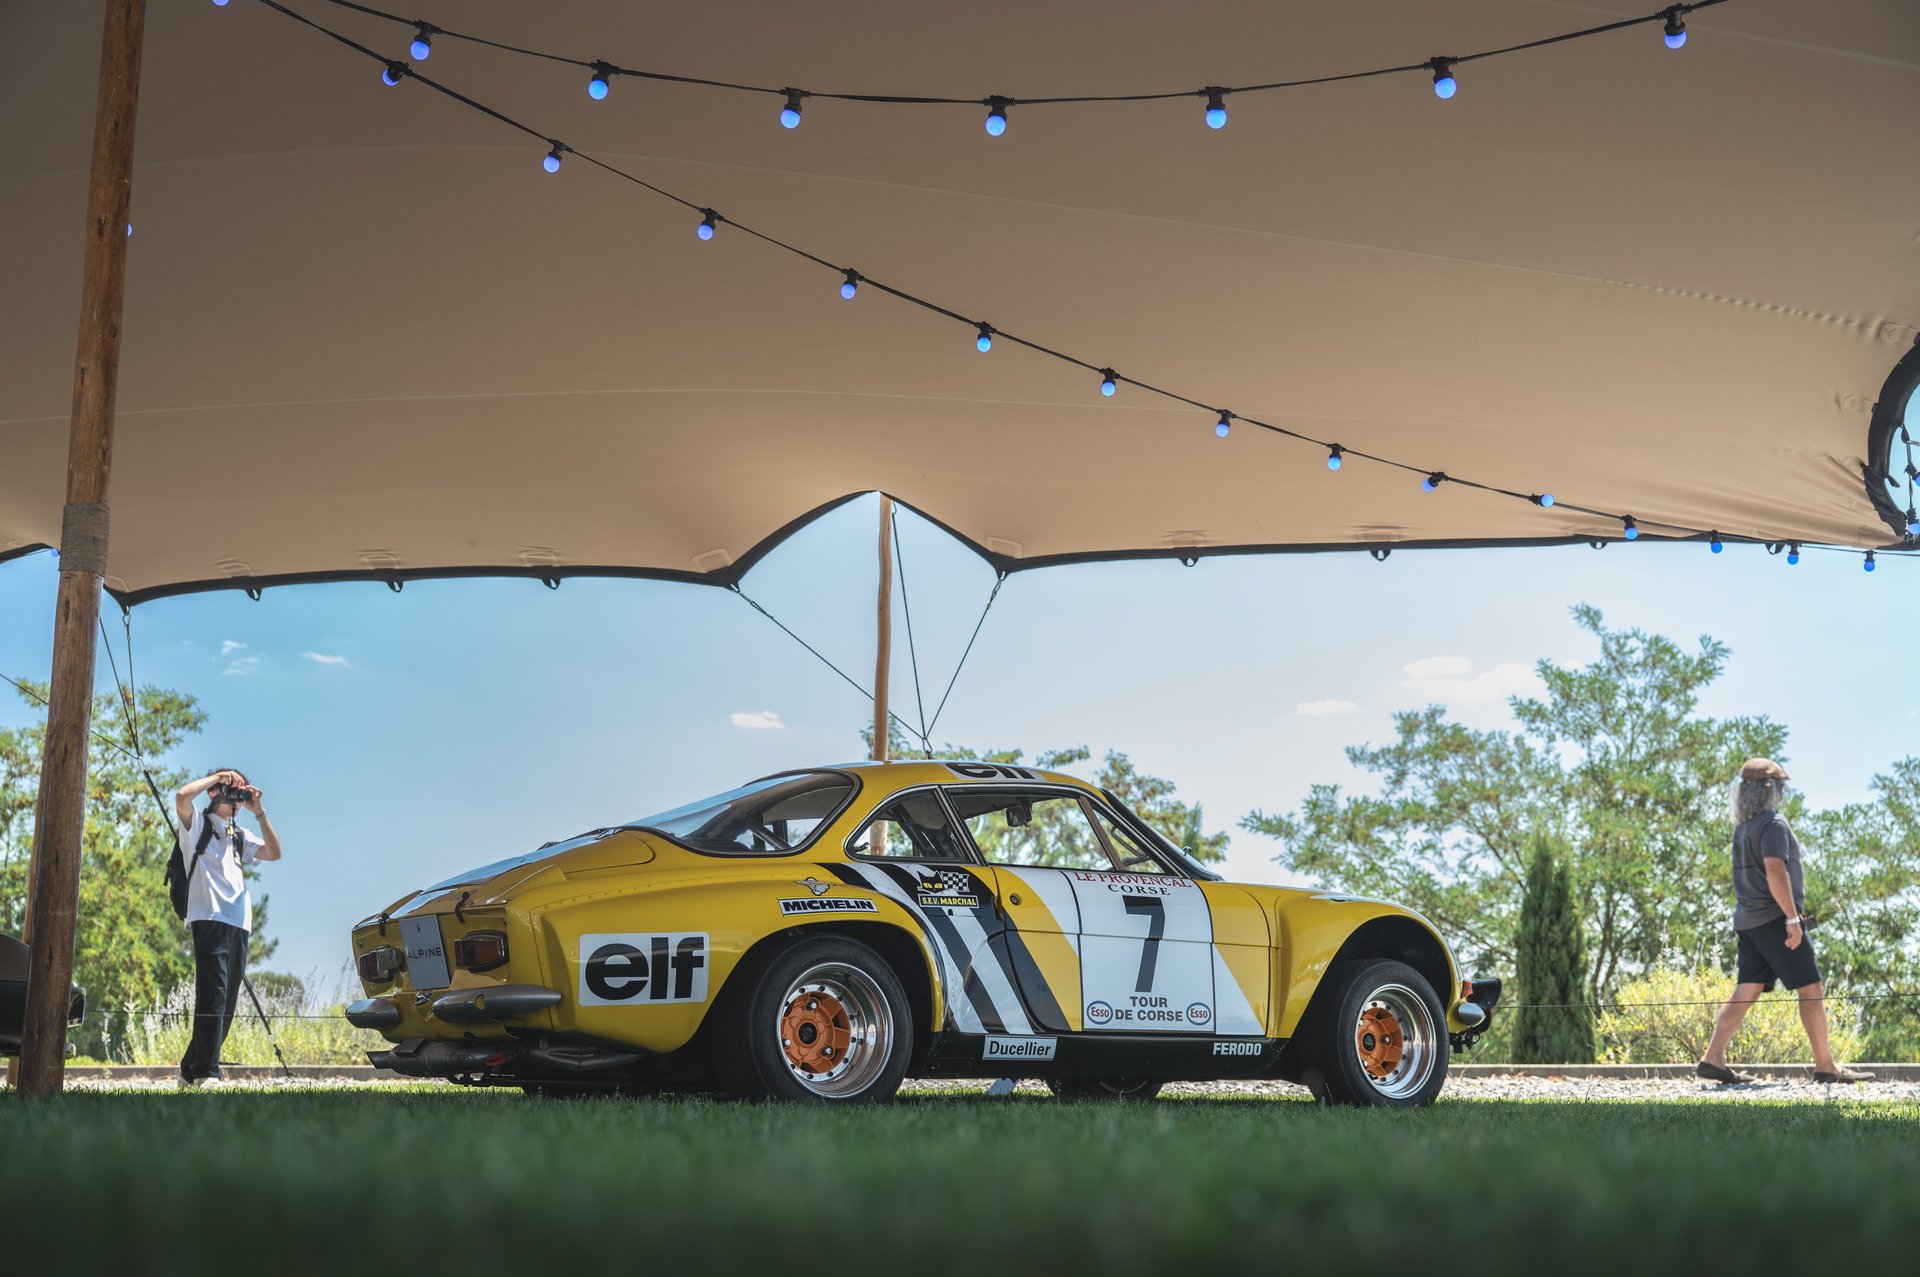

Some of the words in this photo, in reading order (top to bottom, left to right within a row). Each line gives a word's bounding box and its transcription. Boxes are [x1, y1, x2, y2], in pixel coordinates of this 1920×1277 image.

[1074, 872, 1096, 882] LE
[1107, 884, 1171, 896] CORSE
[782, 900, 875, 912] MICHELIN
[940, 897, 977, 906] MARCHAL
[1122, 895, 1166, 993] 7
[407, 946, 442, 960] ALPINE
[585, 936, 705, 1001] elf
[1129, 996, 1168, 1008] TOUR
[1114, 1009, 1133, 1021] DE
[1137, 1010, 1184, 1022] CORSE
[988, 1040, 1052, 1056] Ducellier
[1212, 1042, 1262, 1056] FERODO
